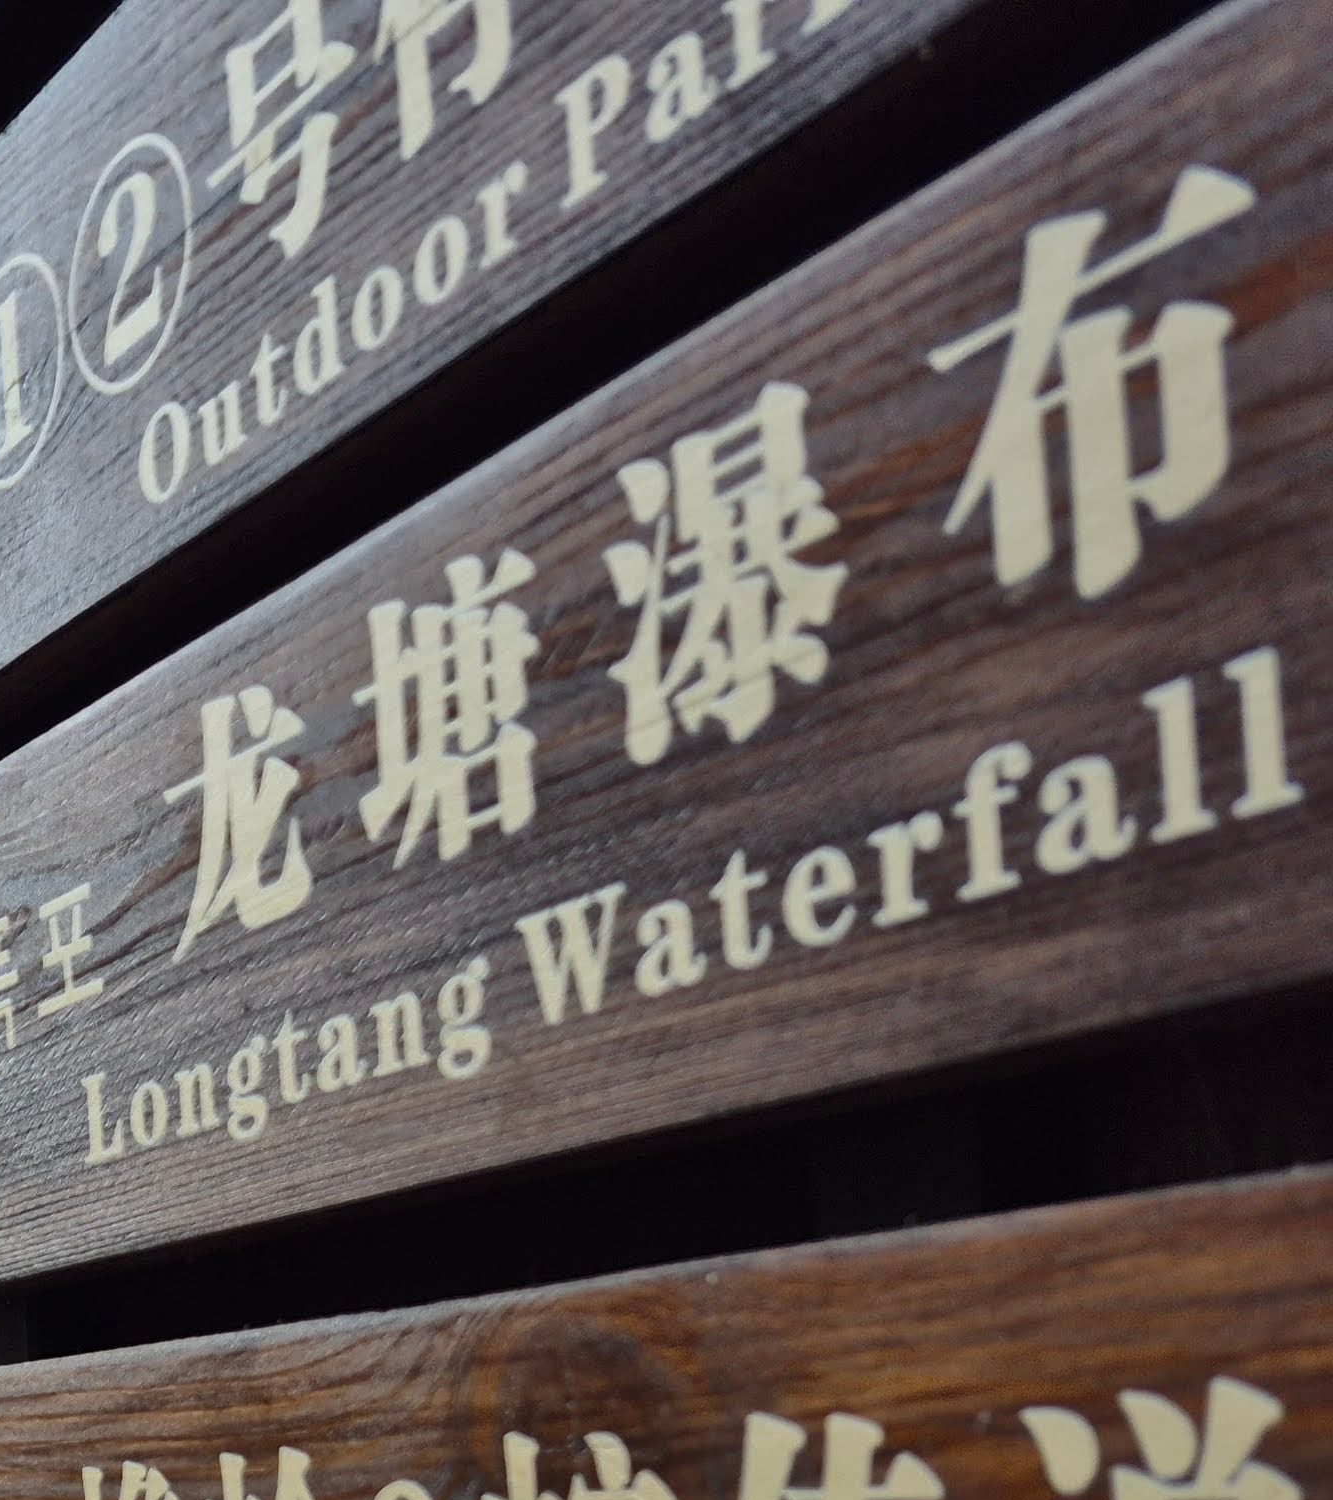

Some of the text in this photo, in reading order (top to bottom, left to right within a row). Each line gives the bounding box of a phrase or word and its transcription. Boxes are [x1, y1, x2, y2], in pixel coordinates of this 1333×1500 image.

[137, 0, 863, 506] Outdoor Par
[164, 164, 1258, 964] 龙塘瀑布
[81, 645, 1304, 1167] Longtang Waterfall
